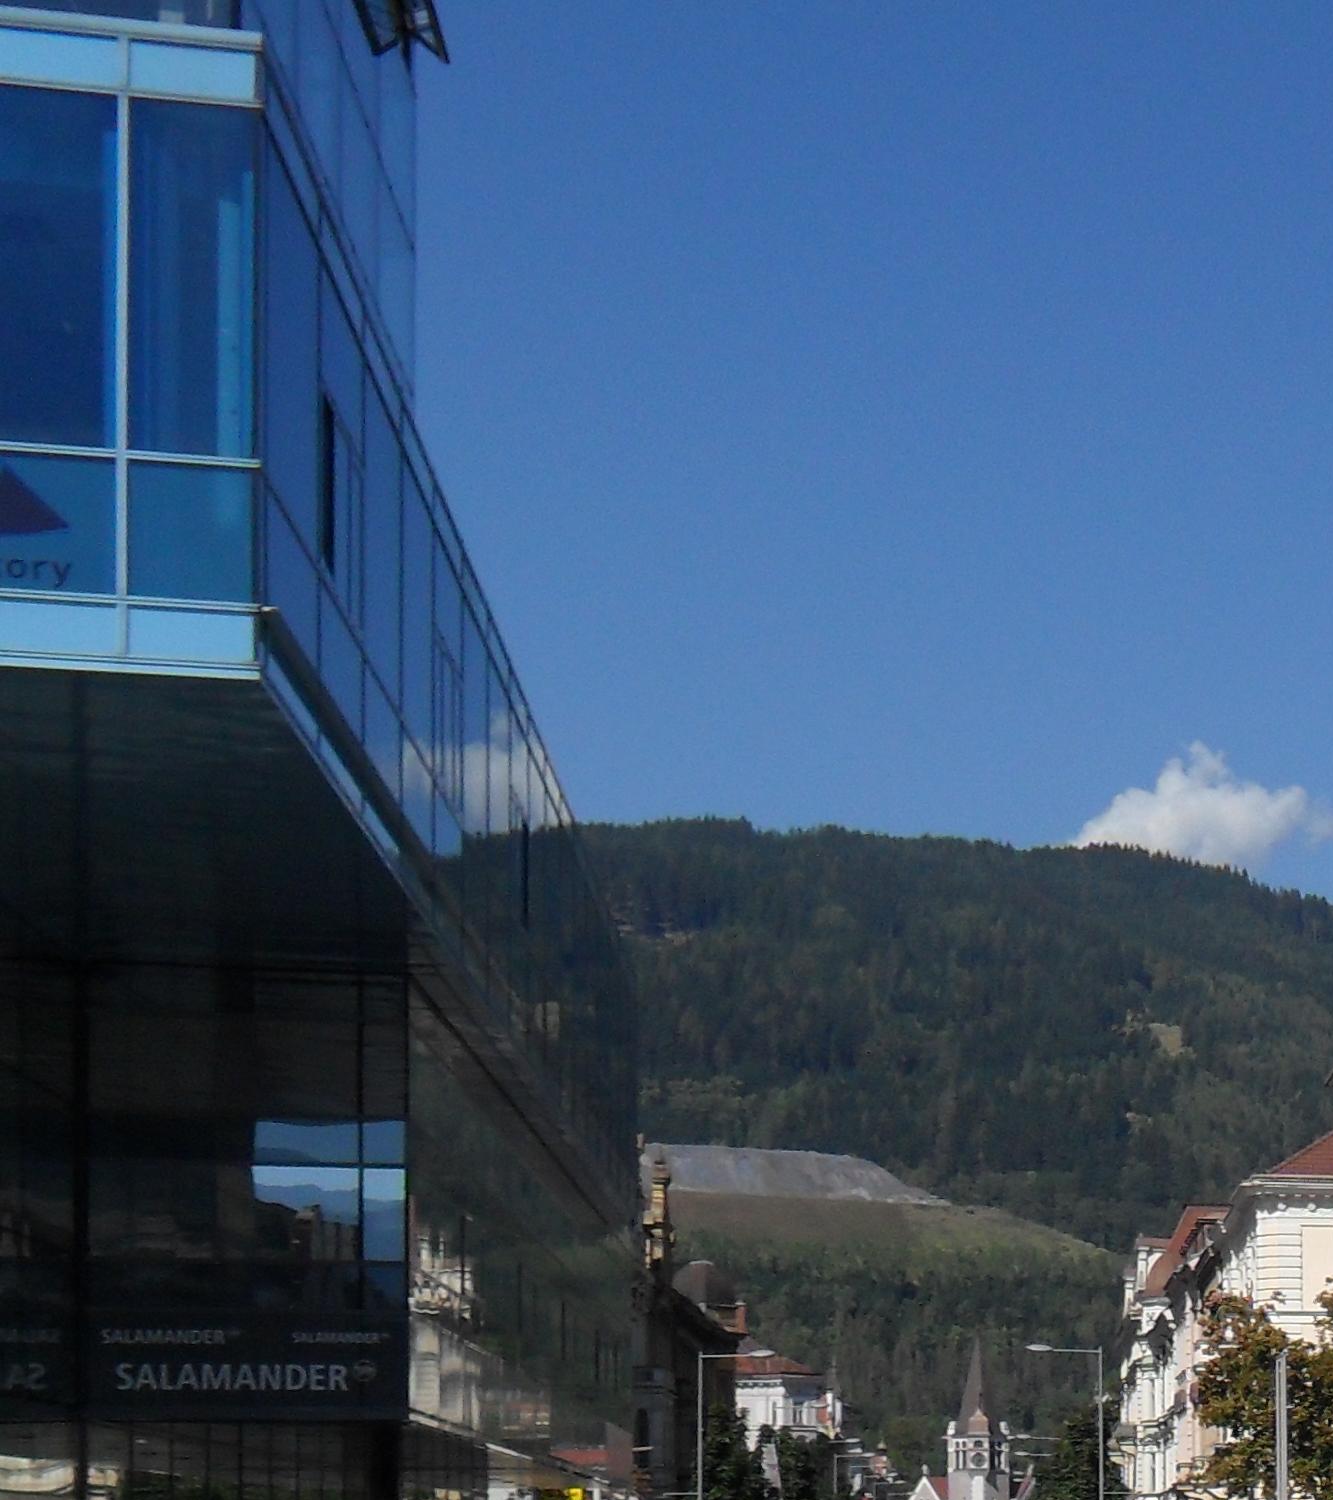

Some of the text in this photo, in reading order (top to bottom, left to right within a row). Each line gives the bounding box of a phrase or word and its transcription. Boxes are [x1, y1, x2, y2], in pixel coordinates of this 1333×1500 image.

[0, 558, 71, 586] ory
[101, 1329, 226, 1345] SALAMANDER
[116, 1363, 349, 1391] SALAMANDER
